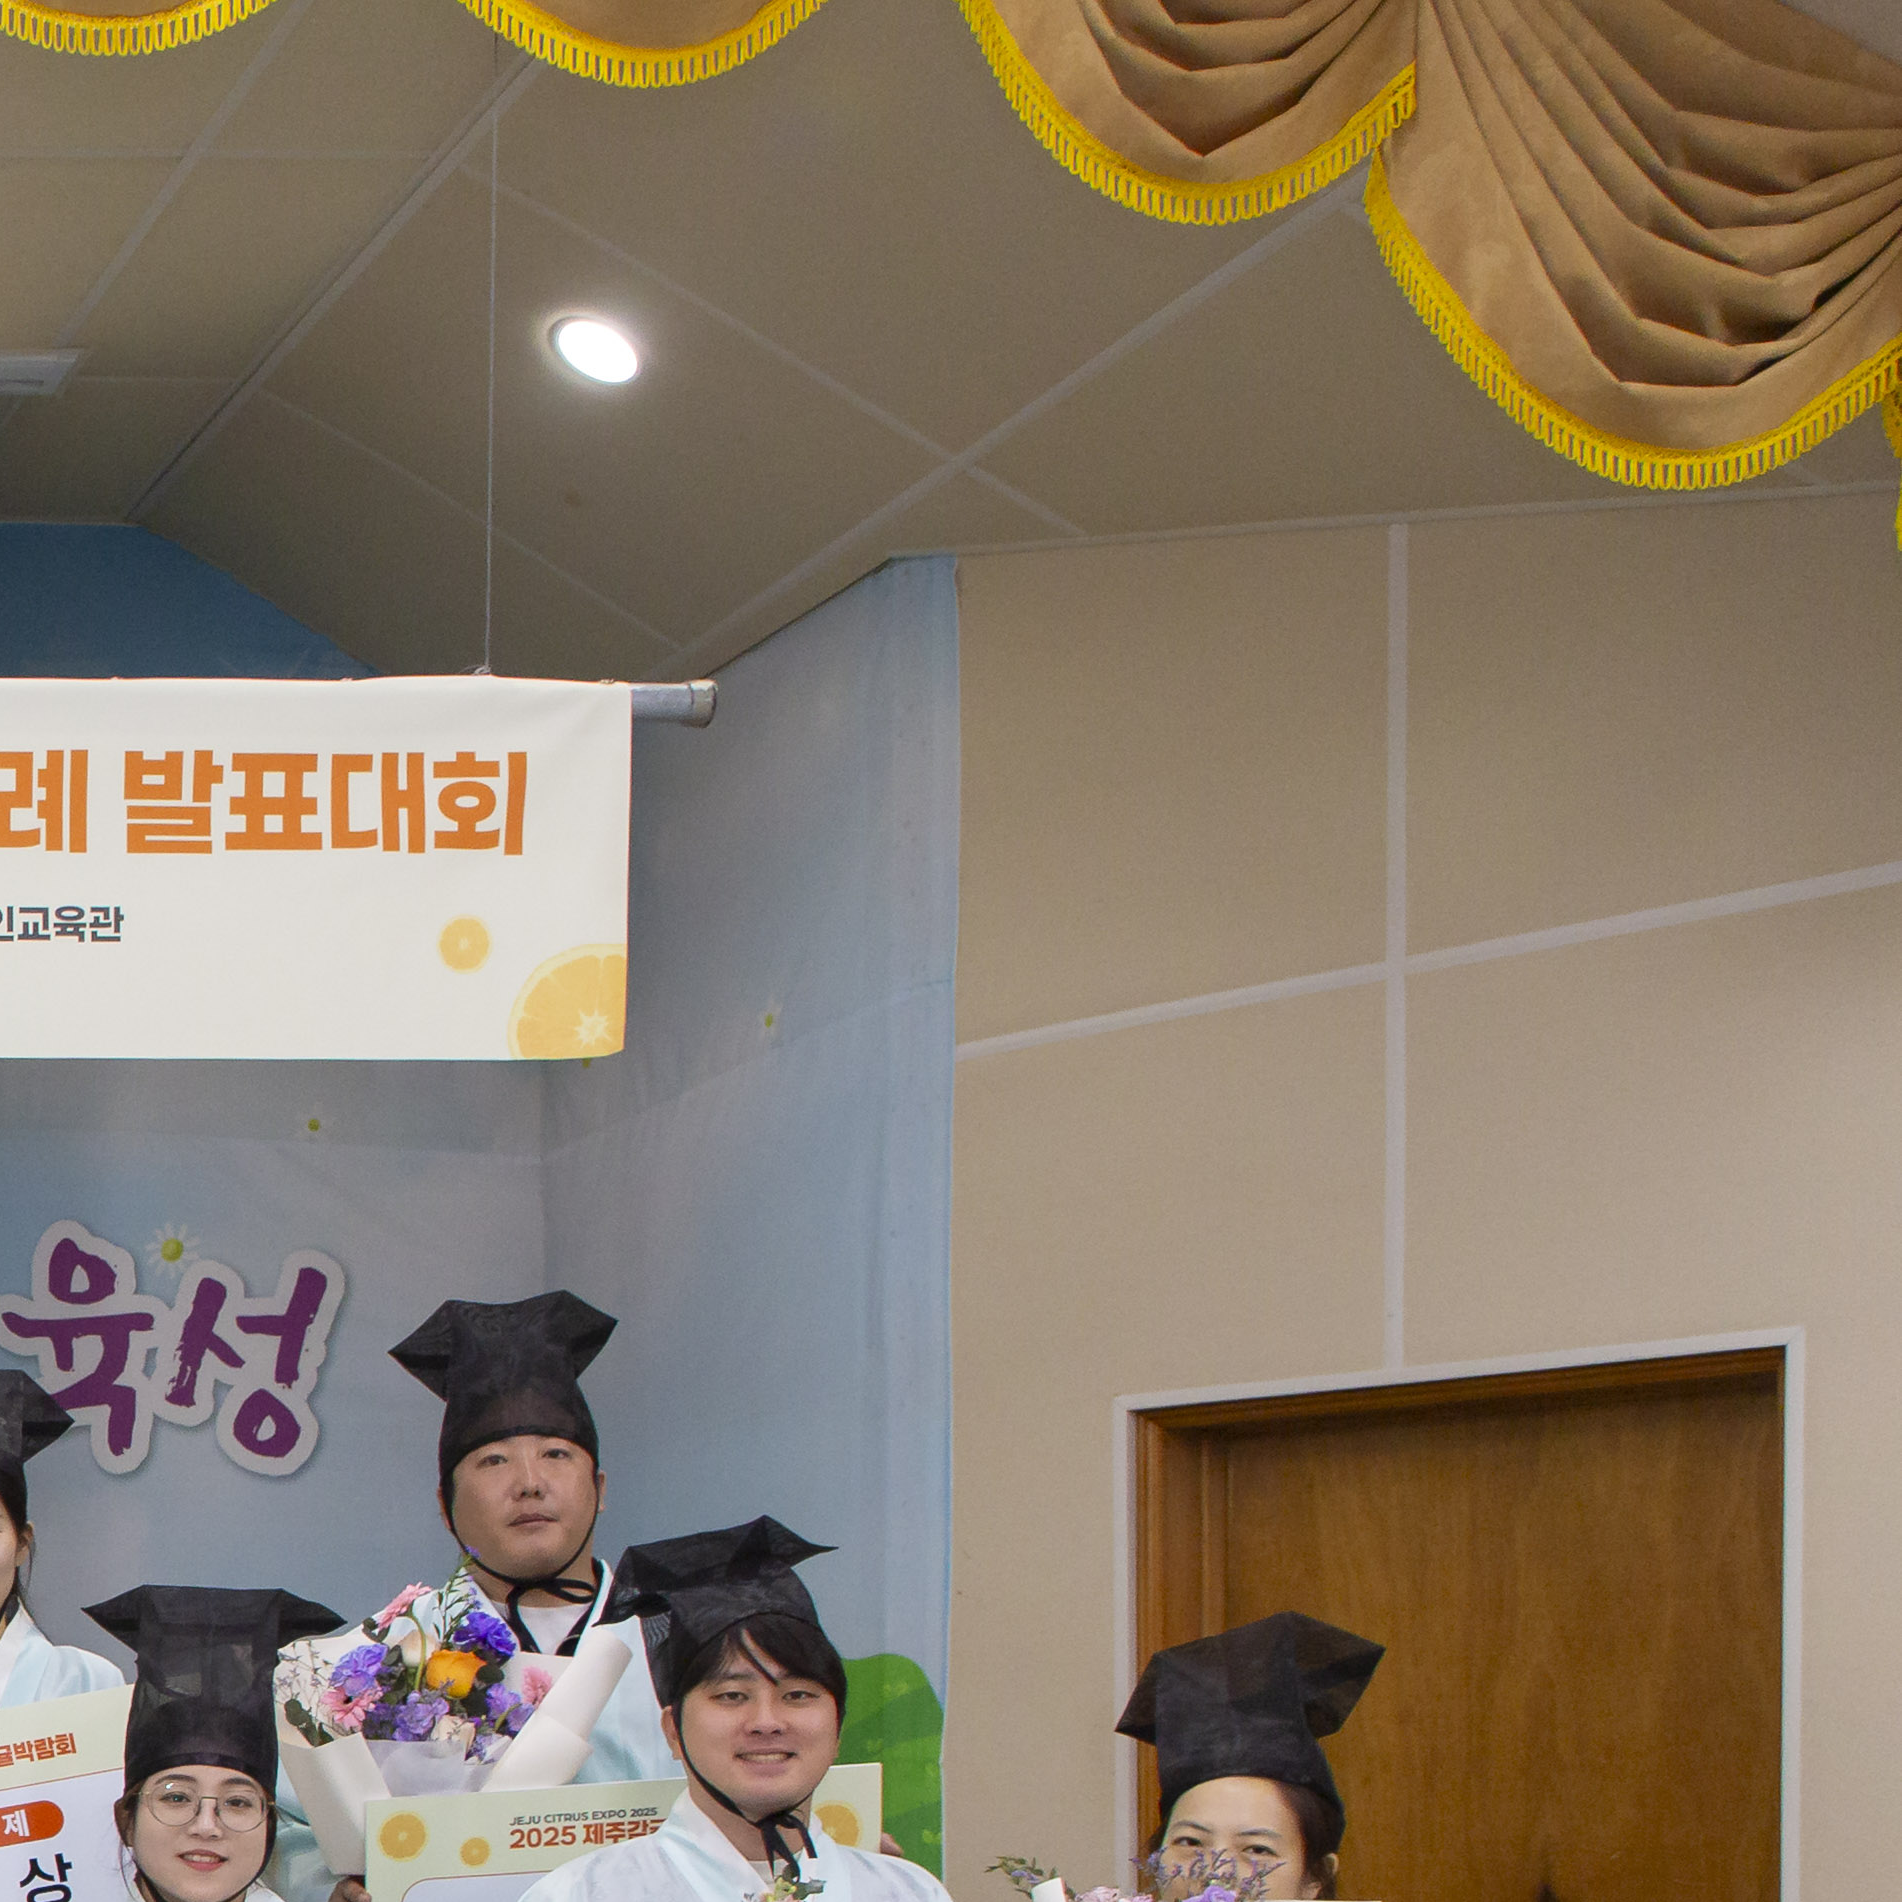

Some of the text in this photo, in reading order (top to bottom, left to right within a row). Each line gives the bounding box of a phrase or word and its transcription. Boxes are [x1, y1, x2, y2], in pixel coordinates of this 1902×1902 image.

[123, 749, 529, 858] 발표대회
[1, 1237, 328, 1459] 육성
[509, 1807, 658, 1827] JEJU CITRUS EXPO 2025
[509, 1825, 577, 1849] 2025
